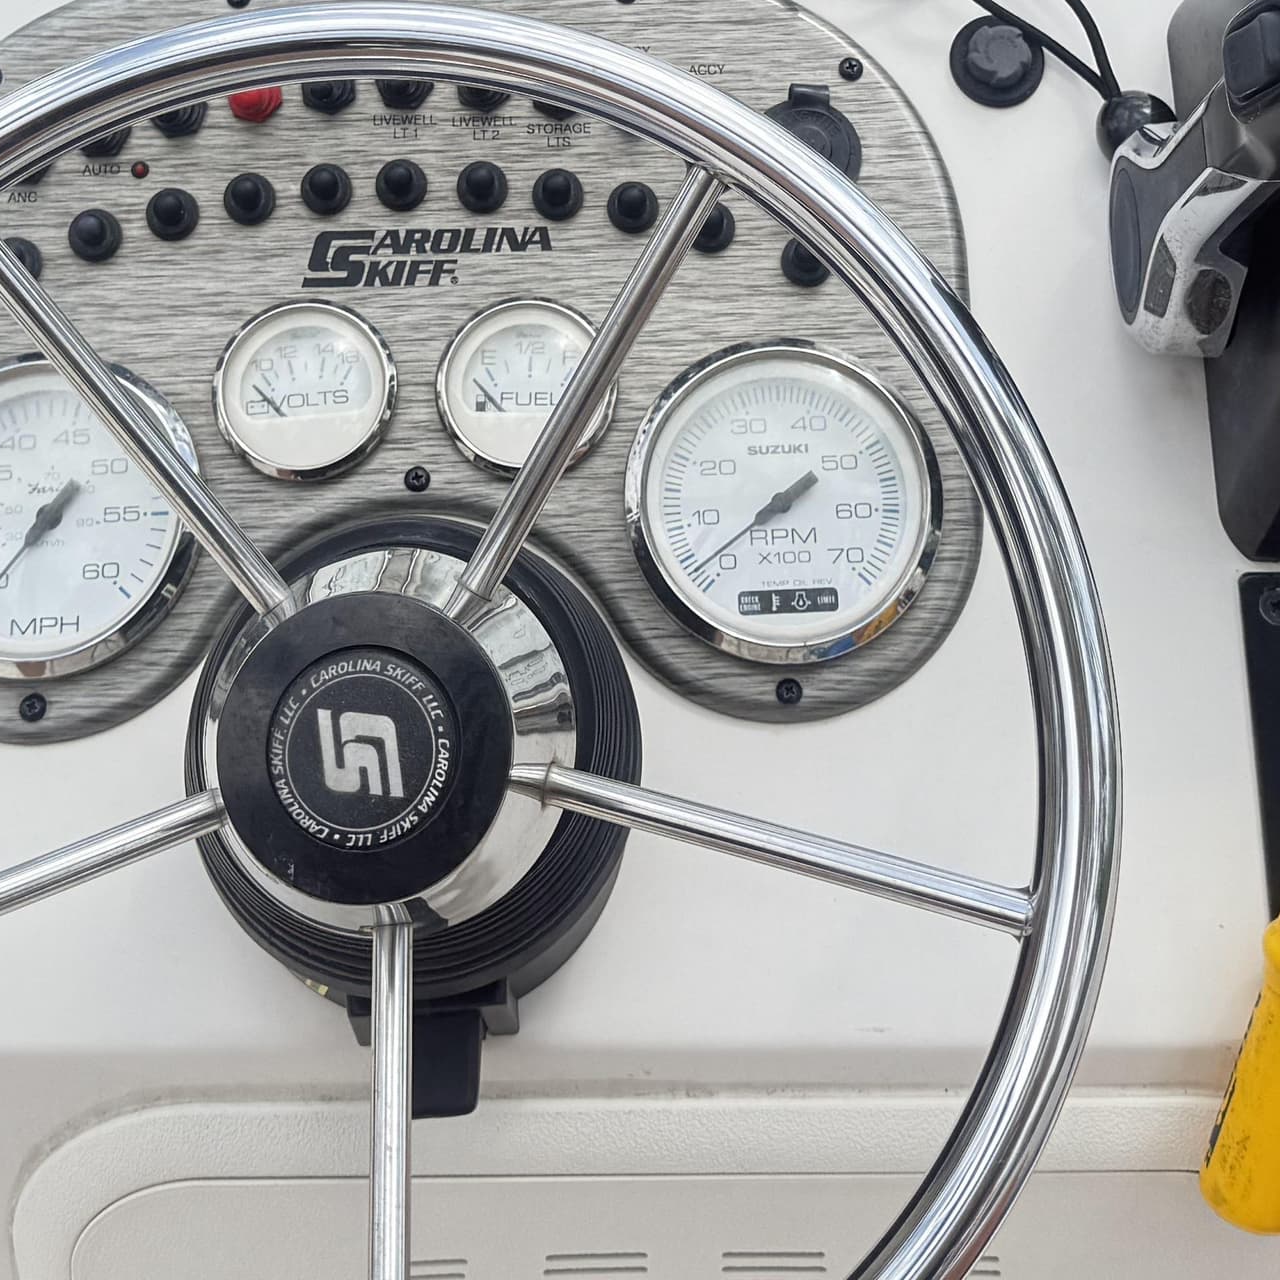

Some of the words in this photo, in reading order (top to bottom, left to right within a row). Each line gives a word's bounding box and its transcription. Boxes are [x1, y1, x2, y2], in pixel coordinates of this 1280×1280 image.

[688, 63, 726, 76] ACCY
[372, 114, 437, 126] LIVEWELL
[451, 115, 517, 128] LIVEWELL
[526, 122, 592, 135] STORAGE
[393, 127, 408, 139] LT
[472, 129, 488, 141] LT
[491, 129, 501, 141] 2
[546, 136, 571, 148] LTS
[82, 163, 121, 177] AUTO
[307, 226, 553, 272] CAROLINA
[301, 244, 458, 288] SKIFF
[276, 345, 297, 359] 12
[314, 343, 335, 356] 14
[515, 341, 545, 355] 1/2
[252, 359, 274, 372] 10
[481, 349, 496, 366] E
[270, 389, 350, 409] VOLTS
[500, 391, 557, 407] FUEL
[731, 417, 767, 435] 30
[790, 415, 827, 432] 40
[53, 428, 91, 446] 45
[747, 443, 809, 456] SUZUKI
[91, 457, 129, 476] 50
[699, 459, 736, 476] 20
[821, 454, 858, 471] 50
[103, 505, 141, 523] 55
[691, 508, 720, 526] 10
[835, 502, 873, 520] 60
[749, 527, 817, 546] RPM
[719, 553, 737, 570] 0
[758, 550, 812, 565] X100
[827, 546, 865, 565] 70
[82, 561, 120, 580] 60
[9, 615, 80, 637] MPH
[309, 658, 382, 689] CAROLINA
[383, 663, 426, 690] SKIFF
[422, 694, 444, 721] LLC
[279, 696, 301, 725] LLC
[419, 738, 451, 814] CAROLINA
[274, 778, 330, 839] CAROLINA
[379, 810, 420, 844] SKIFF
[345, 833, 373, 847] LLC
